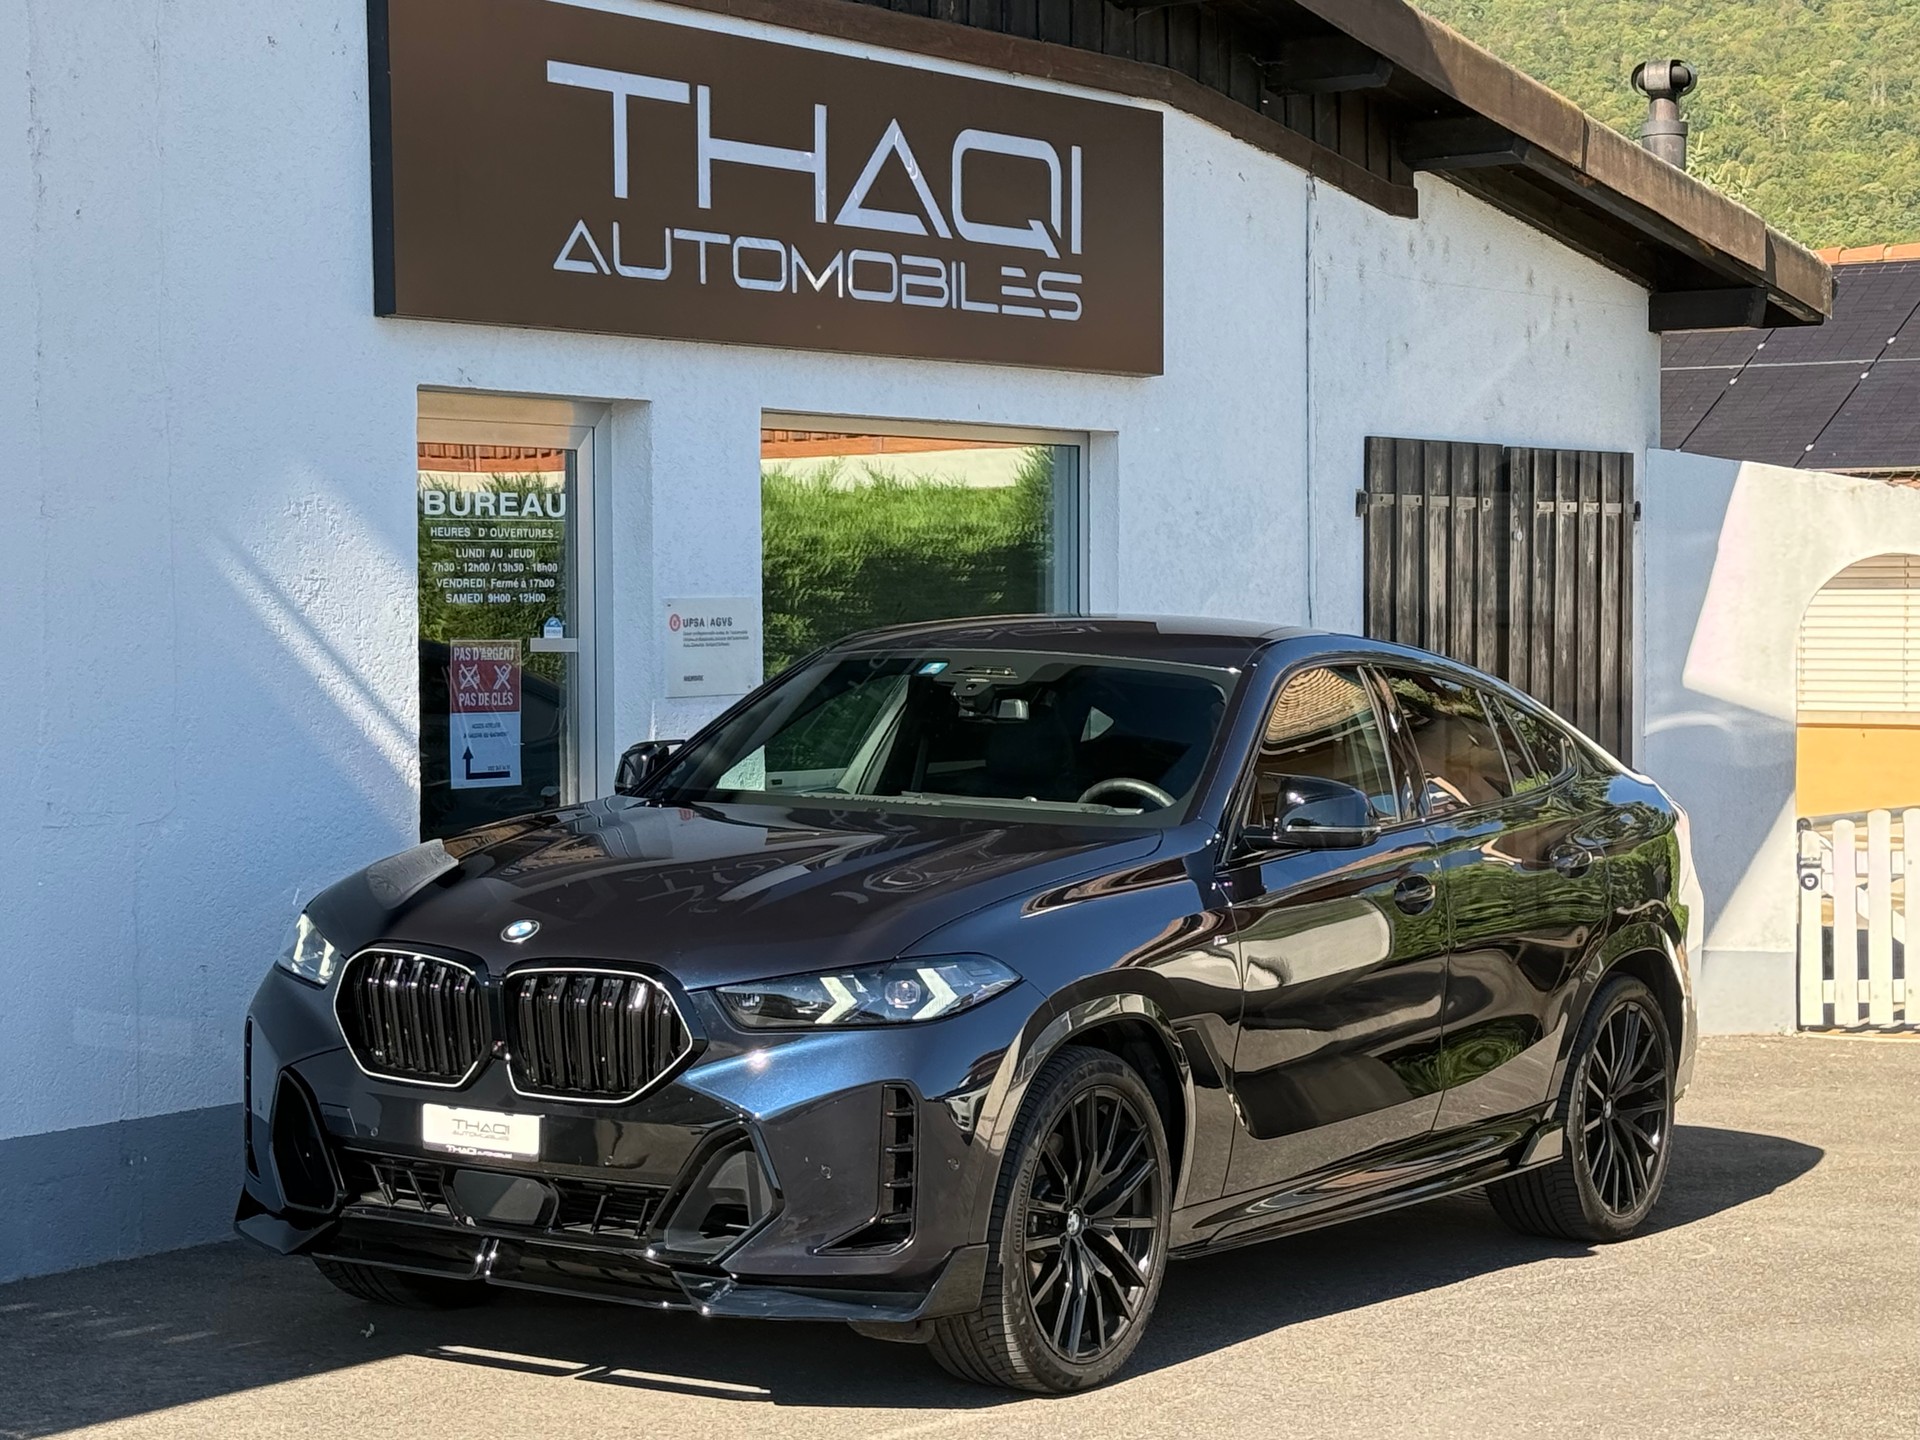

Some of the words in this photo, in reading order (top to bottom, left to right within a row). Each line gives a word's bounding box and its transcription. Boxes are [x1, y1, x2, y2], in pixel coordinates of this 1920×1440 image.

[547, 60, 1083, 258] THAQI
[553, 218, 1083, 322] AUTOMOBILES
[424, 490, 566, 517] BUREAU
[430, 527, 471, 537] HEURES
[455, 548, 485, 559] LUNDI
[490, 549, 503, 558] AU
[507, 549, 536, 558] JEUDI
[432, 562, 455, 572] 7h30
[464, 563, 490, 572] 12h00
[498, 563, 524, 572] 13h30
[436, 578, 486, 588] VENDREDI
[491, 578, 519, 588] Fermé
[529, 579, 555, 588] 17h00
[445, 593, 483, 603] SAMEDI
[487, 593, 511, 602] 9H00
[519, 593, 546, 602] 12H00
[682, 617, 705, 628] UPSA
[709, 616, 733, 627] AGVS
[454, 647, 471, 661] PAS
[473, 646, 516, 661] D'ARGENT
[458, 693, 476, 706] PAS
[478, 692, 489, 706] DE
[452, 1118, 510, 1136] THAQI
